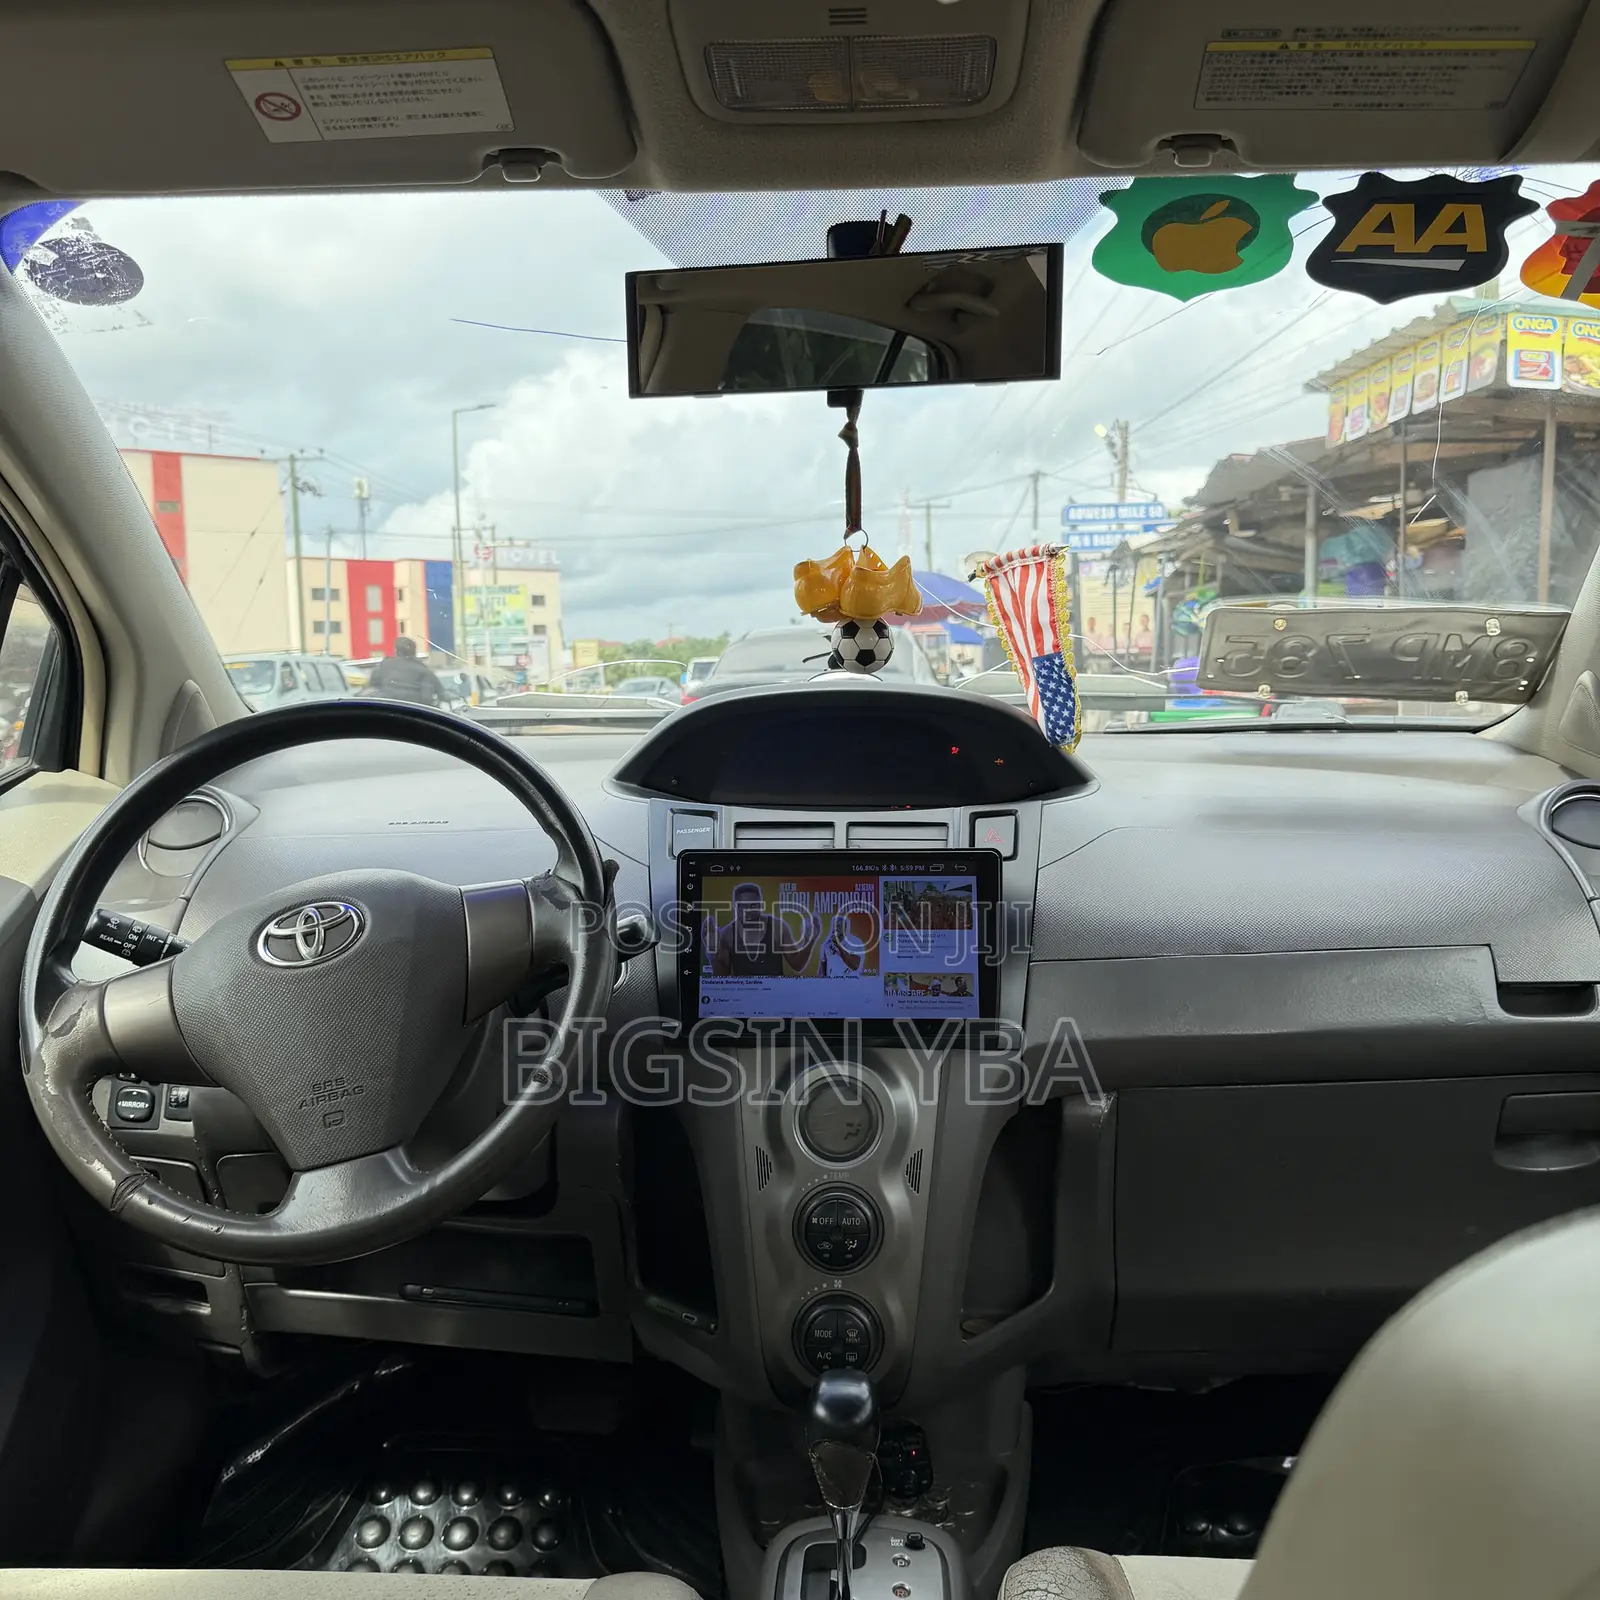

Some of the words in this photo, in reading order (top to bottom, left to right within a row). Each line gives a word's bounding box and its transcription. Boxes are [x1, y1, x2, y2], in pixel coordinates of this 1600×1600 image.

[1336, 203, 1487, 253] AA
[1515, 316, 1555, 331] ONGA
[1574, 322, 1600, 338] ONG
[676, 826, 711, 834] PASSENGER
[900, 864, 914, 872] 5:59
[914, 864, 925, 872] PM
[813, 891, 875, 914] AMPONSAH
[106, 922, 118, 930] PULL
[99, 934, 114, 943] REAR
[146, 934, 158, 942] INT
[123, 942, 136, 951] OFF
[312, 1076, 346, 1092] SRS
[299, 1085, 365, 1110] AIRBAG
[121, 1100, 146, 1109] MIRROR
[829, 1172, 850, 1181] TEMP
[819, 1217, 834, 1226] OFF
[842, 1217, 861, 1226] AUTO
[814, 1329, 833, 1339] MODE
[816, 1351, 832, 1361] A/C
